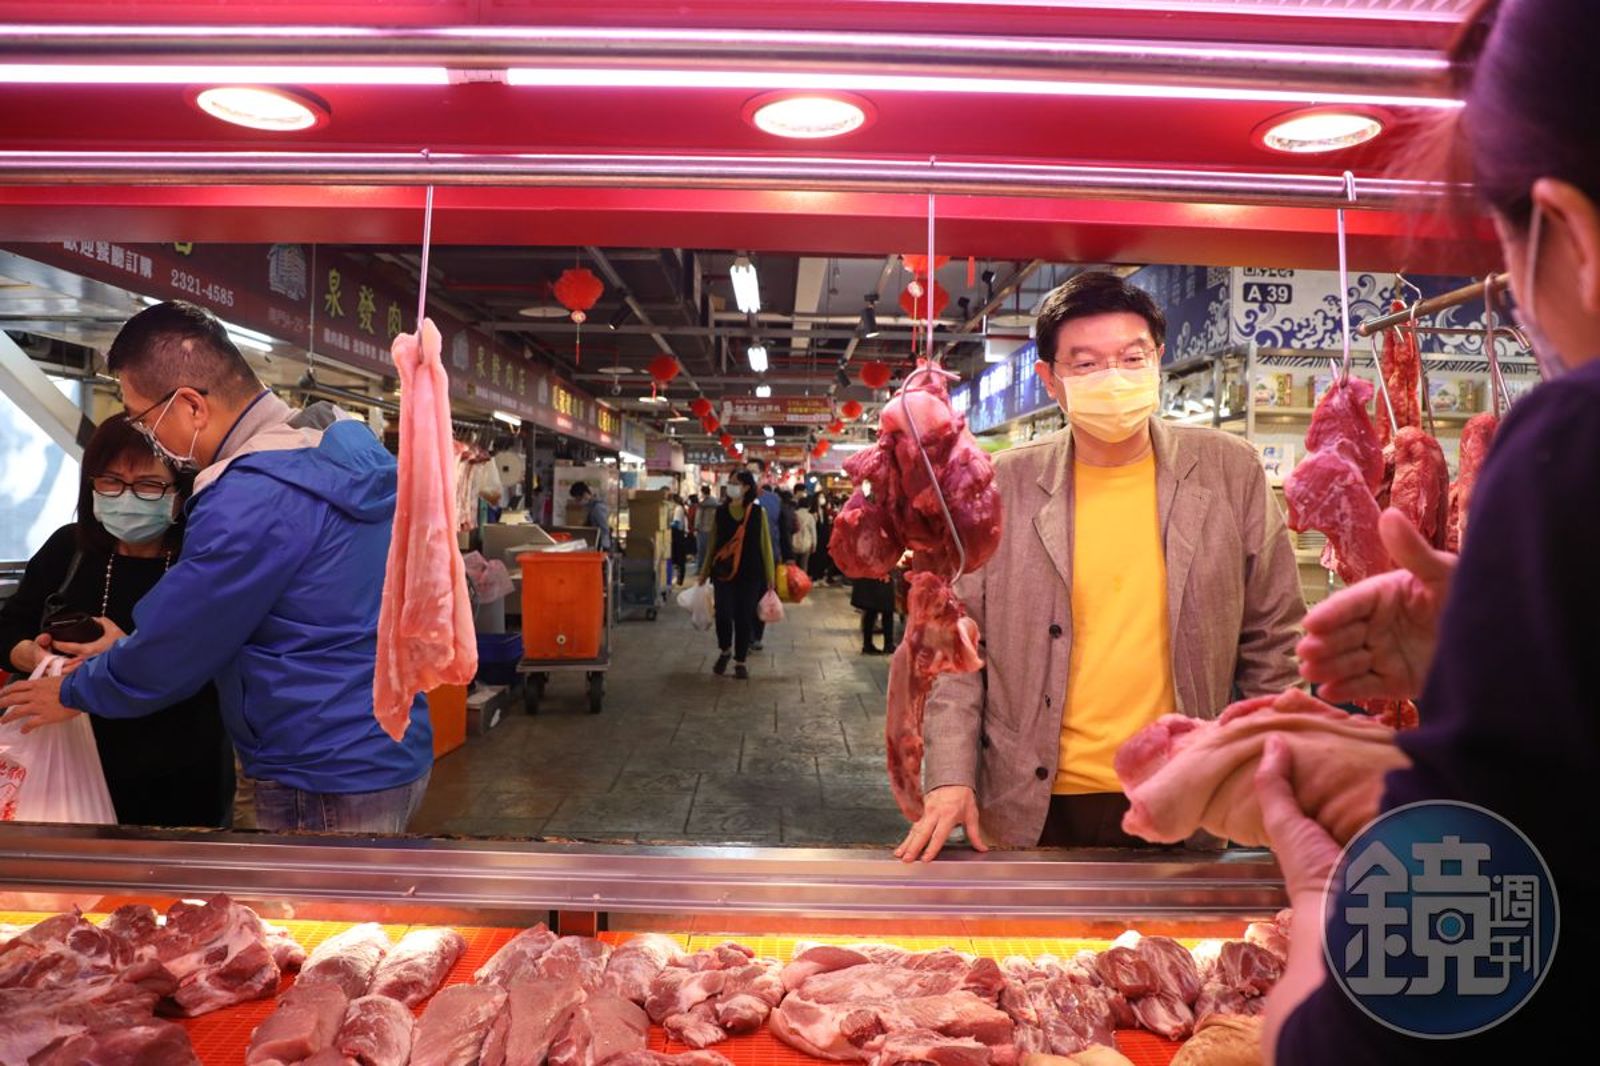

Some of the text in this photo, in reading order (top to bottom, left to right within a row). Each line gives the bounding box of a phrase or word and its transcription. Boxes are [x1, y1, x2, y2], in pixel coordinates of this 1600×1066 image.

[171, 269, 234, 307] 2321-4585
[1247, 284, 1289, 303] A 39
